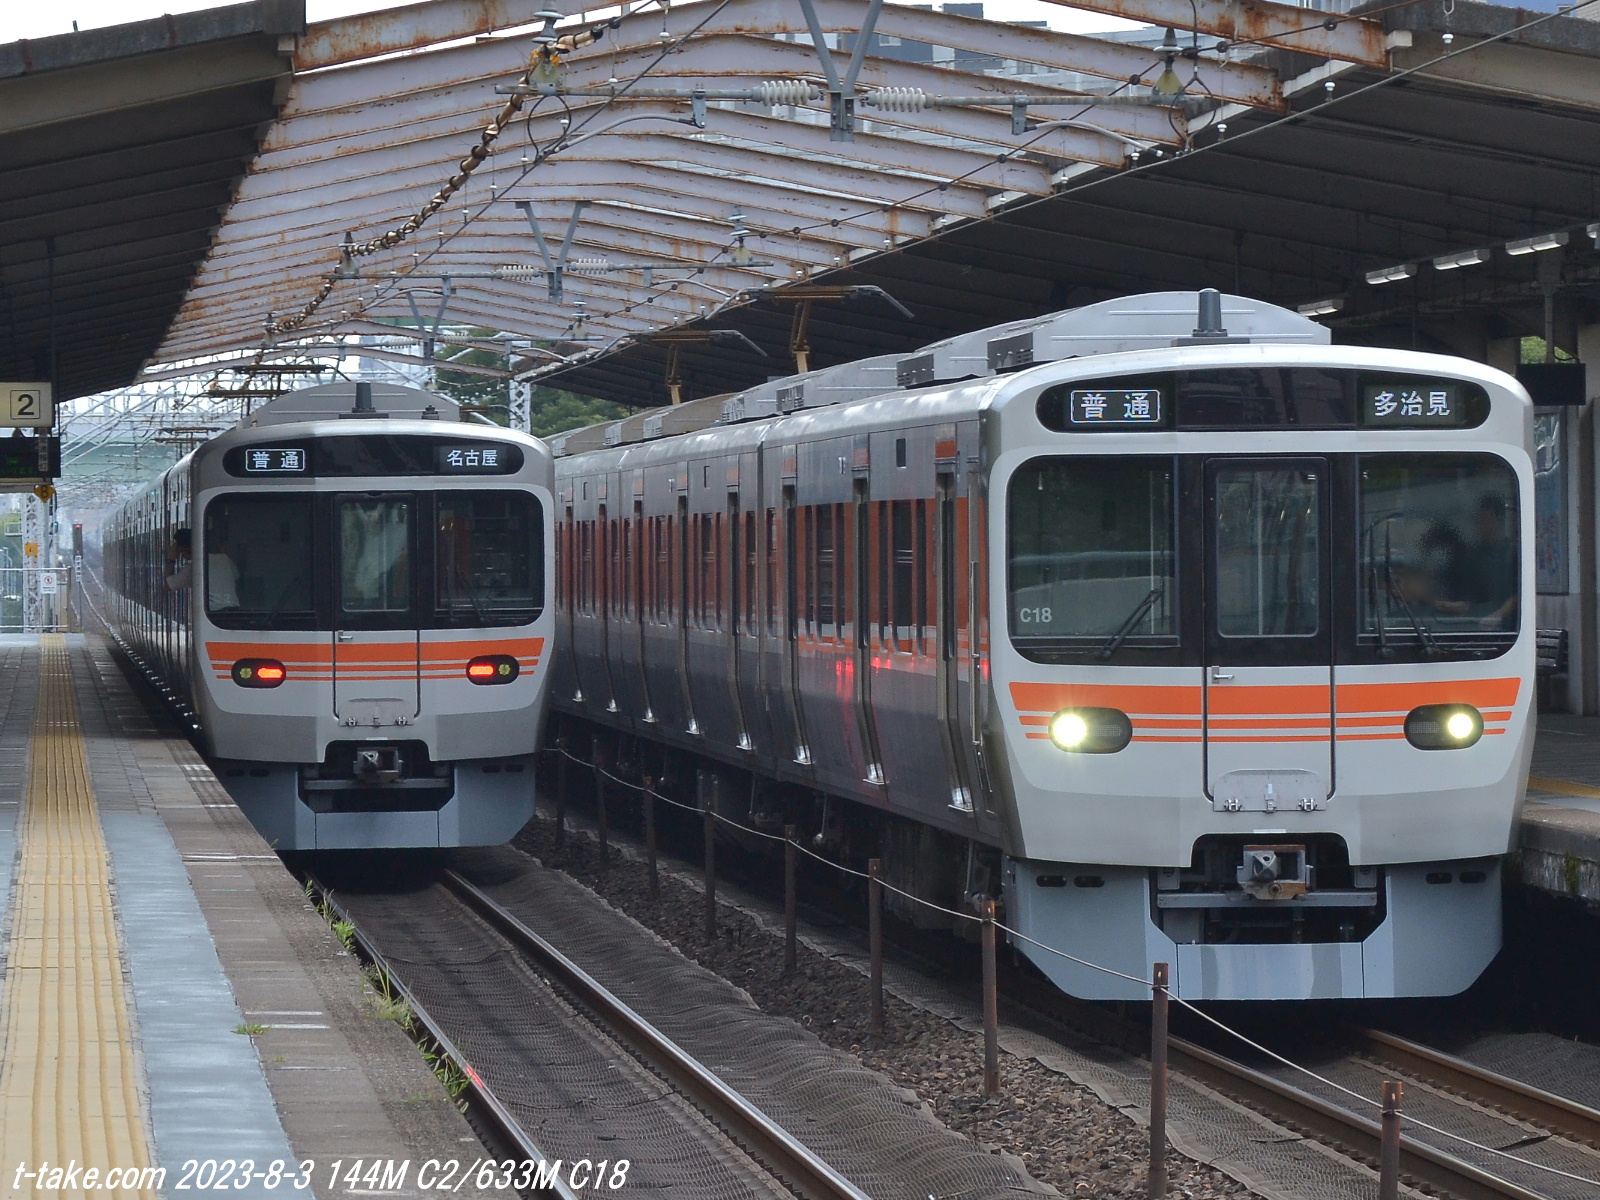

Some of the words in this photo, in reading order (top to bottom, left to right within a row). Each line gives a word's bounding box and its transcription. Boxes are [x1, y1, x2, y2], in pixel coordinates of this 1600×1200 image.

[17, 393, 35, 416] 2
[1080, 392, 1151, 419] 普通
[1374, 390, 1451, 417] 多治見
[252, 451, 299, 469] 普通
[446, 449, 498, 467] 名古屋
[1020, 607, 1052, 623] C18
